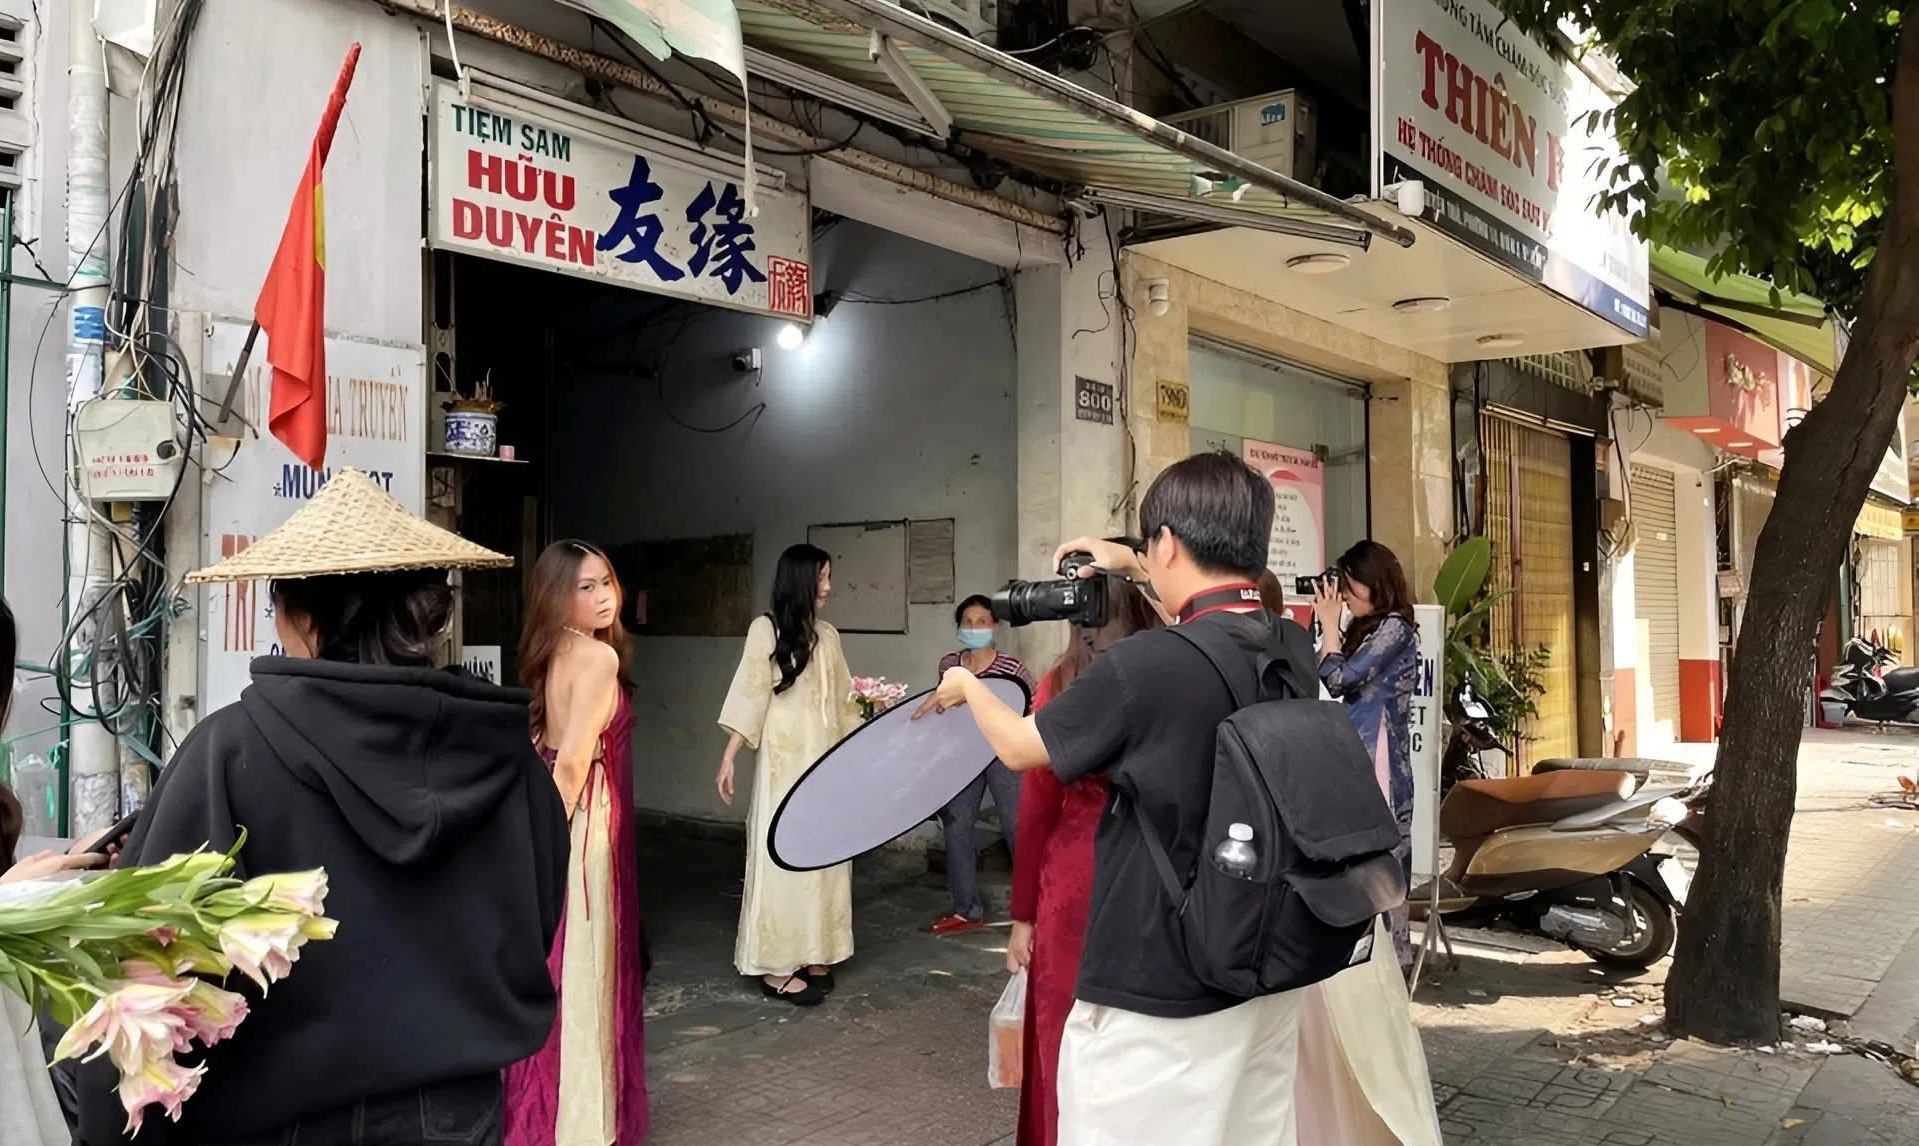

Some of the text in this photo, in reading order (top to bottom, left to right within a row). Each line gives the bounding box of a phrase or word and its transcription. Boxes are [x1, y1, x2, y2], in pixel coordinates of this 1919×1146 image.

[451, 104, 571, 162] TIỆM SAM
[1416, 30, 1537, 178] THIÊN
[468, 150, 576, 211] HỮU
[452, 198, 595, 267] DUYÊN
[1079, 390, 1112, 412] 800
